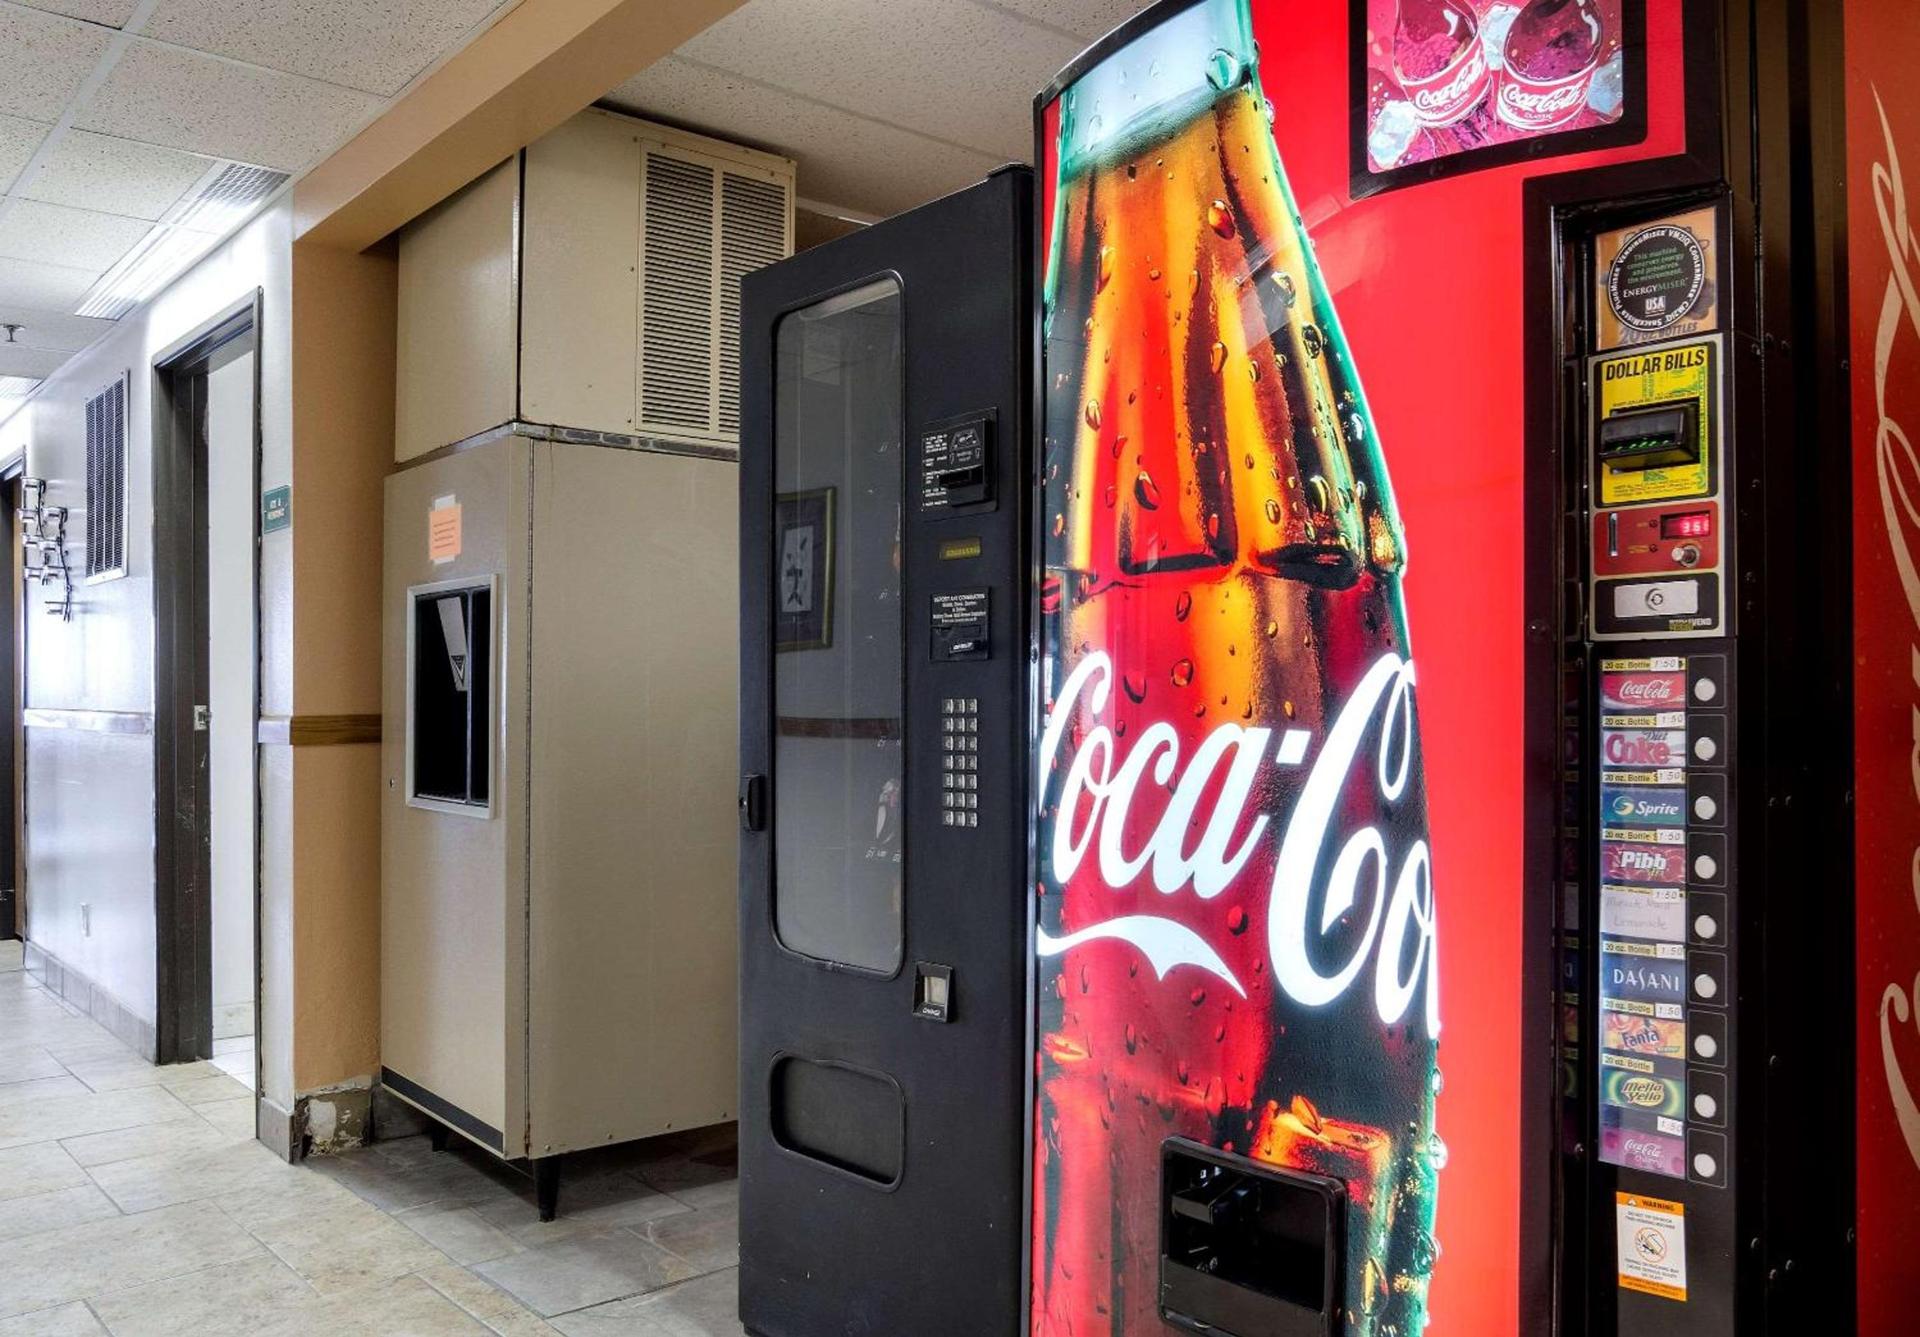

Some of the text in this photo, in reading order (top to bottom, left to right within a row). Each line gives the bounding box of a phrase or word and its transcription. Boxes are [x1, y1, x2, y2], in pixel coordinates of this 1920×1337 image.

[1415, 49, 1484, 110] Coca-Cola
[1503, 76, 1588, 114] Coca-Cola
[1646, 297, 1665, 310] USA
[1606, 349, 1705, 381] DOLLAR BILLS
[1619, 680, 1673, 699] Coca-Cola
[1605, 733, 1671, 765] Coke
[1635, 801, 1679, 817] Sprite
[1620, 851, 1667, 870] Pibb
[1613, 967, 1680, 992] DASANI
[1621, 1029, 1660, 1048] Fanta
[1623, 1081, 1664, 1093] Mello
[1628, 1091, 1663, 1104] Yello
[1624, 1138, 1662, 1158] Coca-Cola
[1641, 1200, 1675, 1211] WARNING
